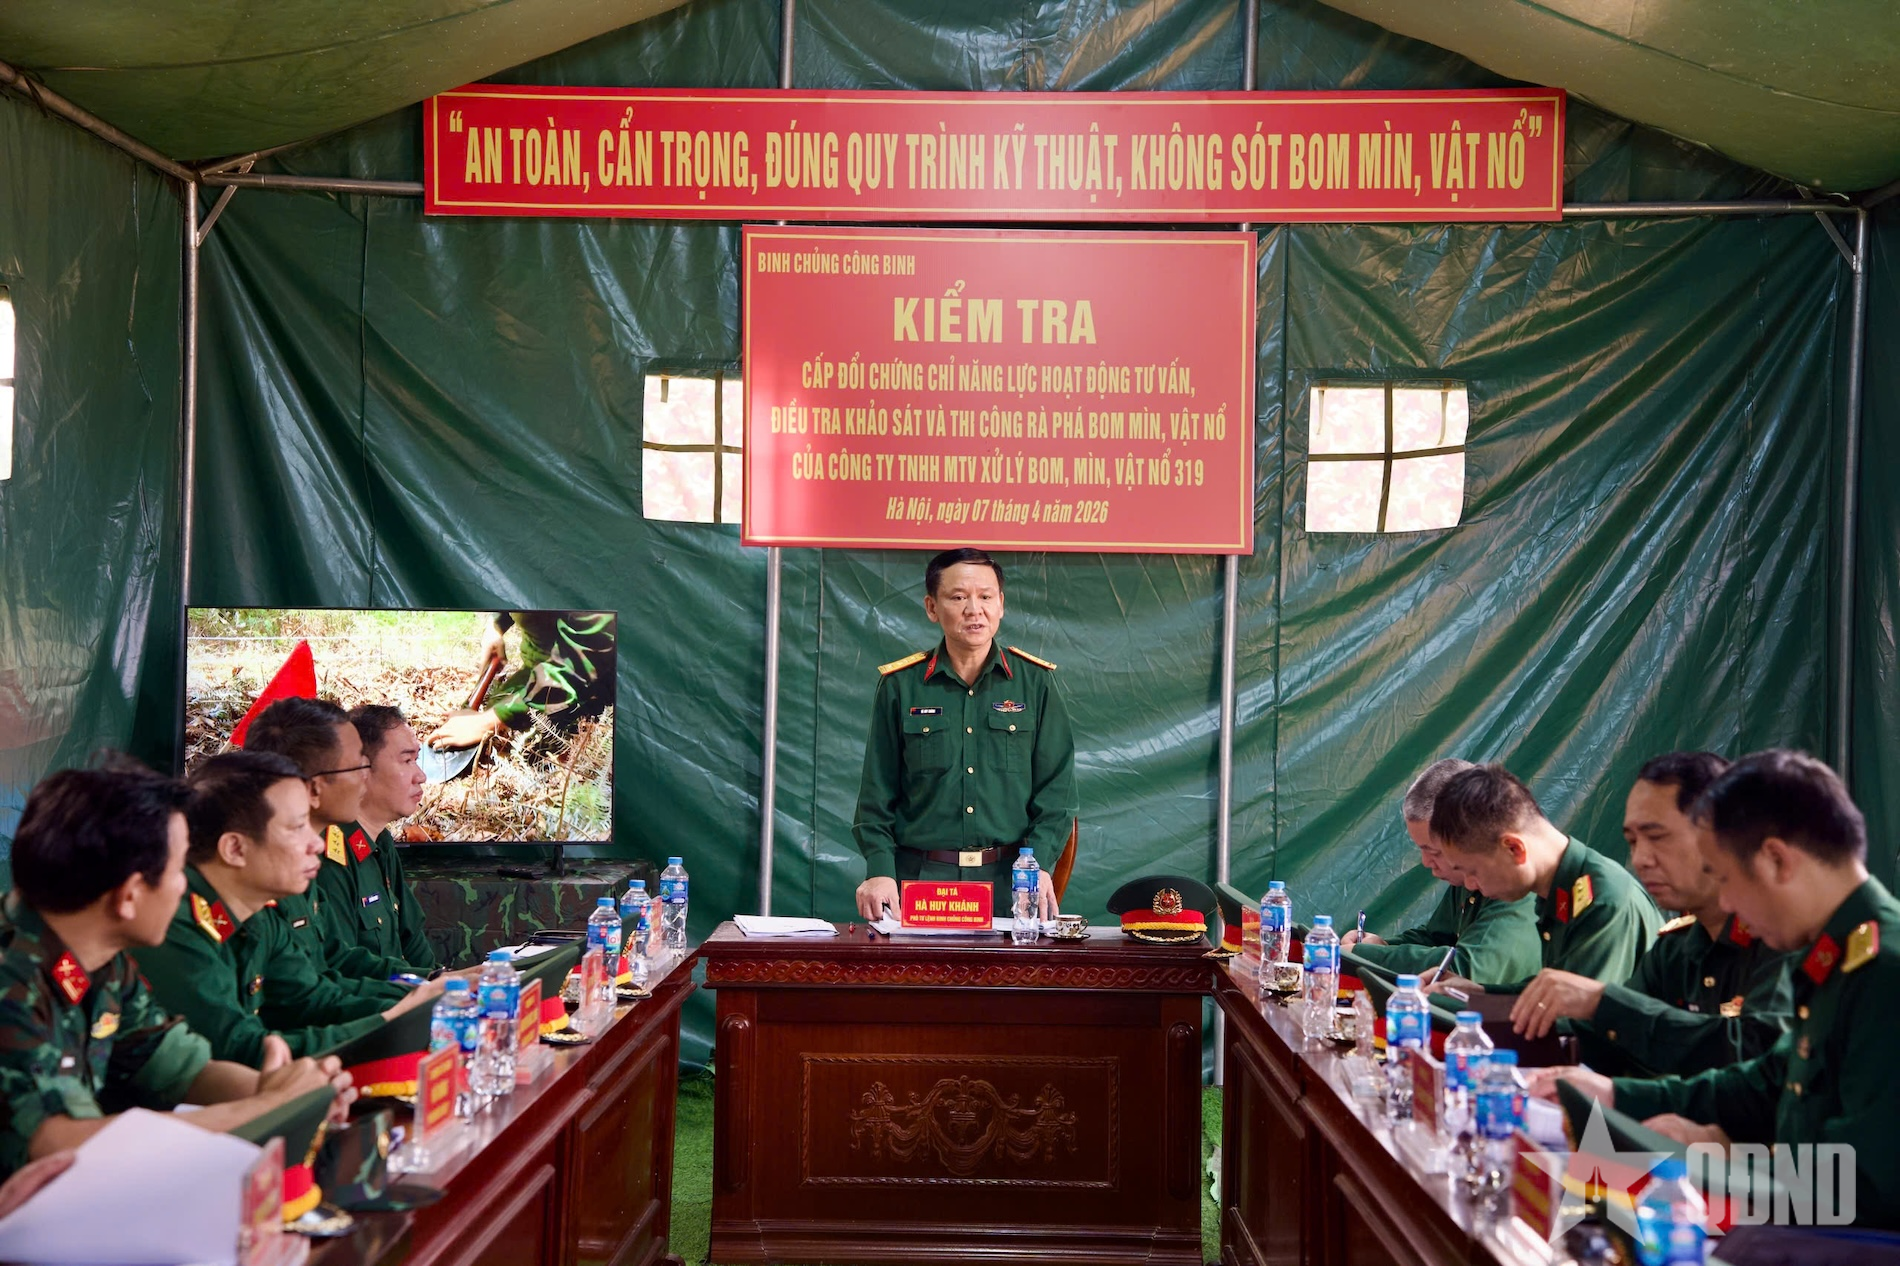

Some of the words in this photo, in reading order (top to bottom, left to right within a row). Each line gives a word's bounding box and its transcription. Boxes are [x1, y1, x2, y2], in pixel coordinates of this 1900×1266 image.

[510, 117, 589, 193] TOÀN,
[599, 106, 653, 185] CẨN
[660, 130, 758, 200] TRỌNG,
[765, 119, 839, 189] ĐÚNG
[847, 133, 899, 195] QUY
[906, 121, 983, 190] TRÌNH
[993, 123, 1027, 190] KỸ
[1033, 122, 1122, 203] THUẬT,
[1131, 122, 1223, 191] KHÔNG
[1231, 121, 1282, 191] SÓT
[1289, 133, 1350, 190] BOM
[1358, 120, 1421, 196] MÌN,
[1429, 120, 1481, 202] VẬT
[758, 252, 790, 273] BINH
[794, 247, 839, 274] CHỦNG
[843, 250, 879, 274] CÔNG
[883, 255, 915, 275] BINH
[894, 280, 1003, 343] KIỂM
[1017, 298, 1097, 344] TRA
[802, 352, 833, 389] CẤP
[838, 352, 864, 389] ĐỔI
[869, 358, 923, 390] CHỨNG
[928, 356, 954, 391] CHỈ
[959, 359, 1003, 392] NĂNG
[1007, 363, 1037, 398] LỰC
[1042, 366, 1083, 399] HOẠT
[1086, 361, 1130, 399] ĐỘNG
[1135, 364, 1156, 393] TƯ
[1158, 357, 1195, 397] VẤN,
[771, 398, 807, 434] ĐIỀU
[812, 407, 841, 434] TRA
[846, 400, 887, 435] KHẢO
[893, 404, 922, 436] SÁT
[926, 404, 946, 437] VÀ
[950, 410, 975, 437] THI
[979, 405, 1022, 438] CÔNG
[1027, 406, 1048, 438] RÀ
[1053, 406, 1084, 438] PHÁ
[1089, 412, 1124, 439] BOM
[1129, 407, 1166, 443] MÌN,
[1170, 407, 1199, 446] VẬT
[1204, 403, 1227, 440] NỔ
[793, 444, 824, 480] CỦA
[828, 448, 872, 481] CÔNG
[876, 454, 894, 481] TY
[898, 455, 939, 482] TNHH
[944, 456, 977, 483] MTV
[981, 447, 1004, 484] XỬ
[1006, 452, 1024, 483] LÝ
[1028, 457, 1069, 487] BOM,
[1074, 452, 1110, 488] MÌN,
[1115, 453, 1144, 491] VẬT
[1148, 448, 1171, 485] NỔ
[1175, 459, 1204, 486] 319
[886, 497, 904, 520] Hà
[907, 498, 933, 525] Nội,
[937, 498, 970, 524] ngày
[972, 499, 990, 521] 07
[991, 499, 1029, 525] tháng
[1032, 500, 1040, 522] 4
[1043, 500, 1073, 523] năm
[1074, 500, 1109, 523] 2026
[915, 899, 927, 910] HÀ
[930, 901, 947, 911] HUY
[949, 899, 979, 912] KHÁNH
[937, 888, 948, 896] ĐẠI
[950, 887, 958, 896] TÁ
